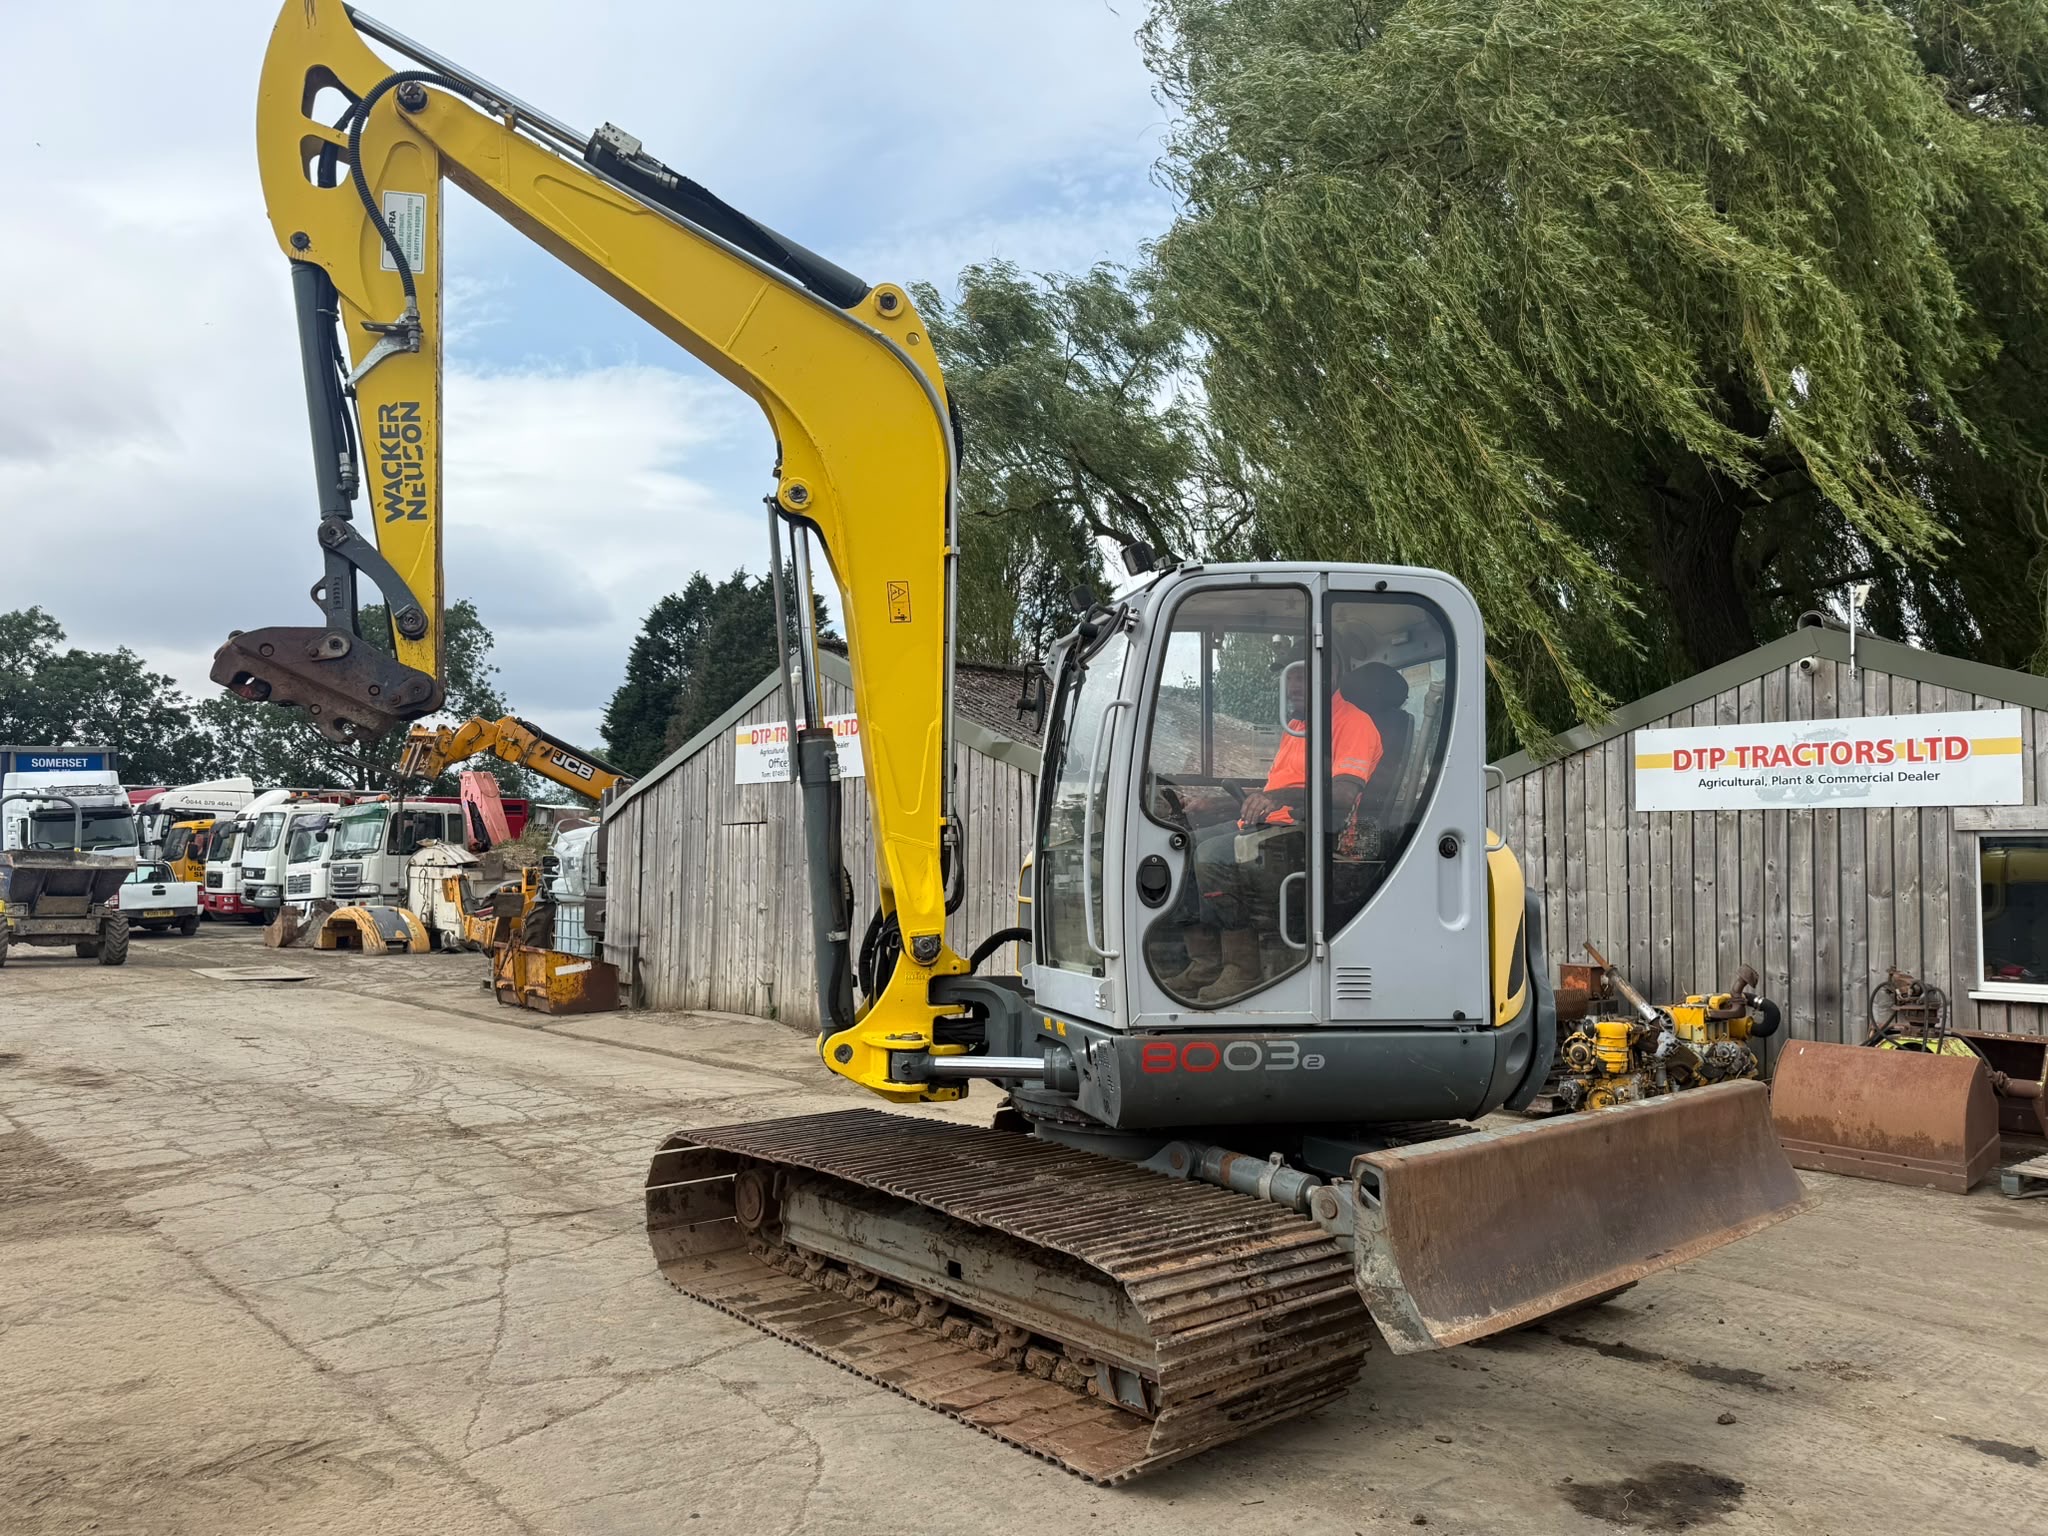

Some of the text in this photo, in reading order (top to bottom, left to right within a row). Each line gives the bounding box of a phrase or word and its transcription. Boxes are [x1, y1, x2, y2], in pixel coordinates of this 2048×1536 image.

[378, 401, 405, 524] WACKER
[399, 401, 427, 521] NEUSON
[751, 728, 771, 745] DTP
[837, 719, 859, 736] LTD
[31, 757, 89, 768] SOMERSET
[552, 753, 594, 779] JCB
[1673, 736, 1969, 771] DTP TRACTORS LTD
[1698, 770, 1941, 789] Agricultural, Plant & Commercial Dealer
